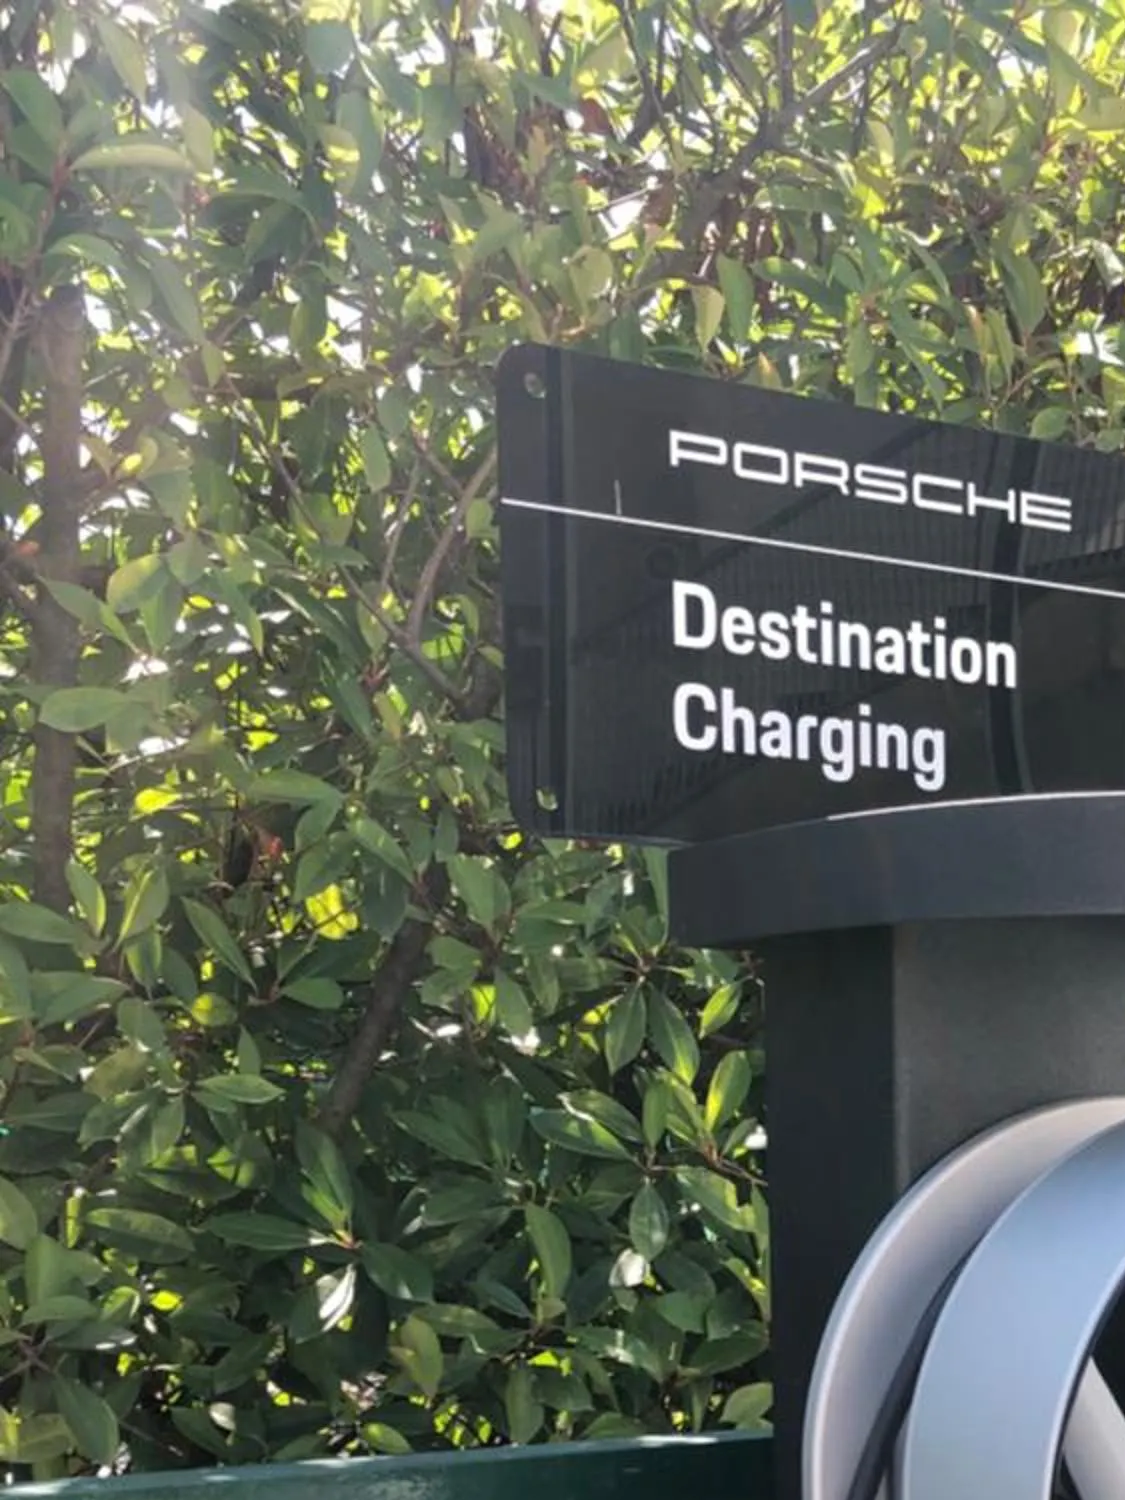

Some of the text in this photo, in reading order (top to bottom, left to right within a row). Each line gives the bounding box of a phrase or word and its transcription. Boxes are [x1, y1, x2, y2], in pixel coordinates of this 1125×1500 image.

[669, 429, 1072, 533] PORSCHE
[672, 580, 1018, 689] Destination
[673, 682, 946, 792] Charging
